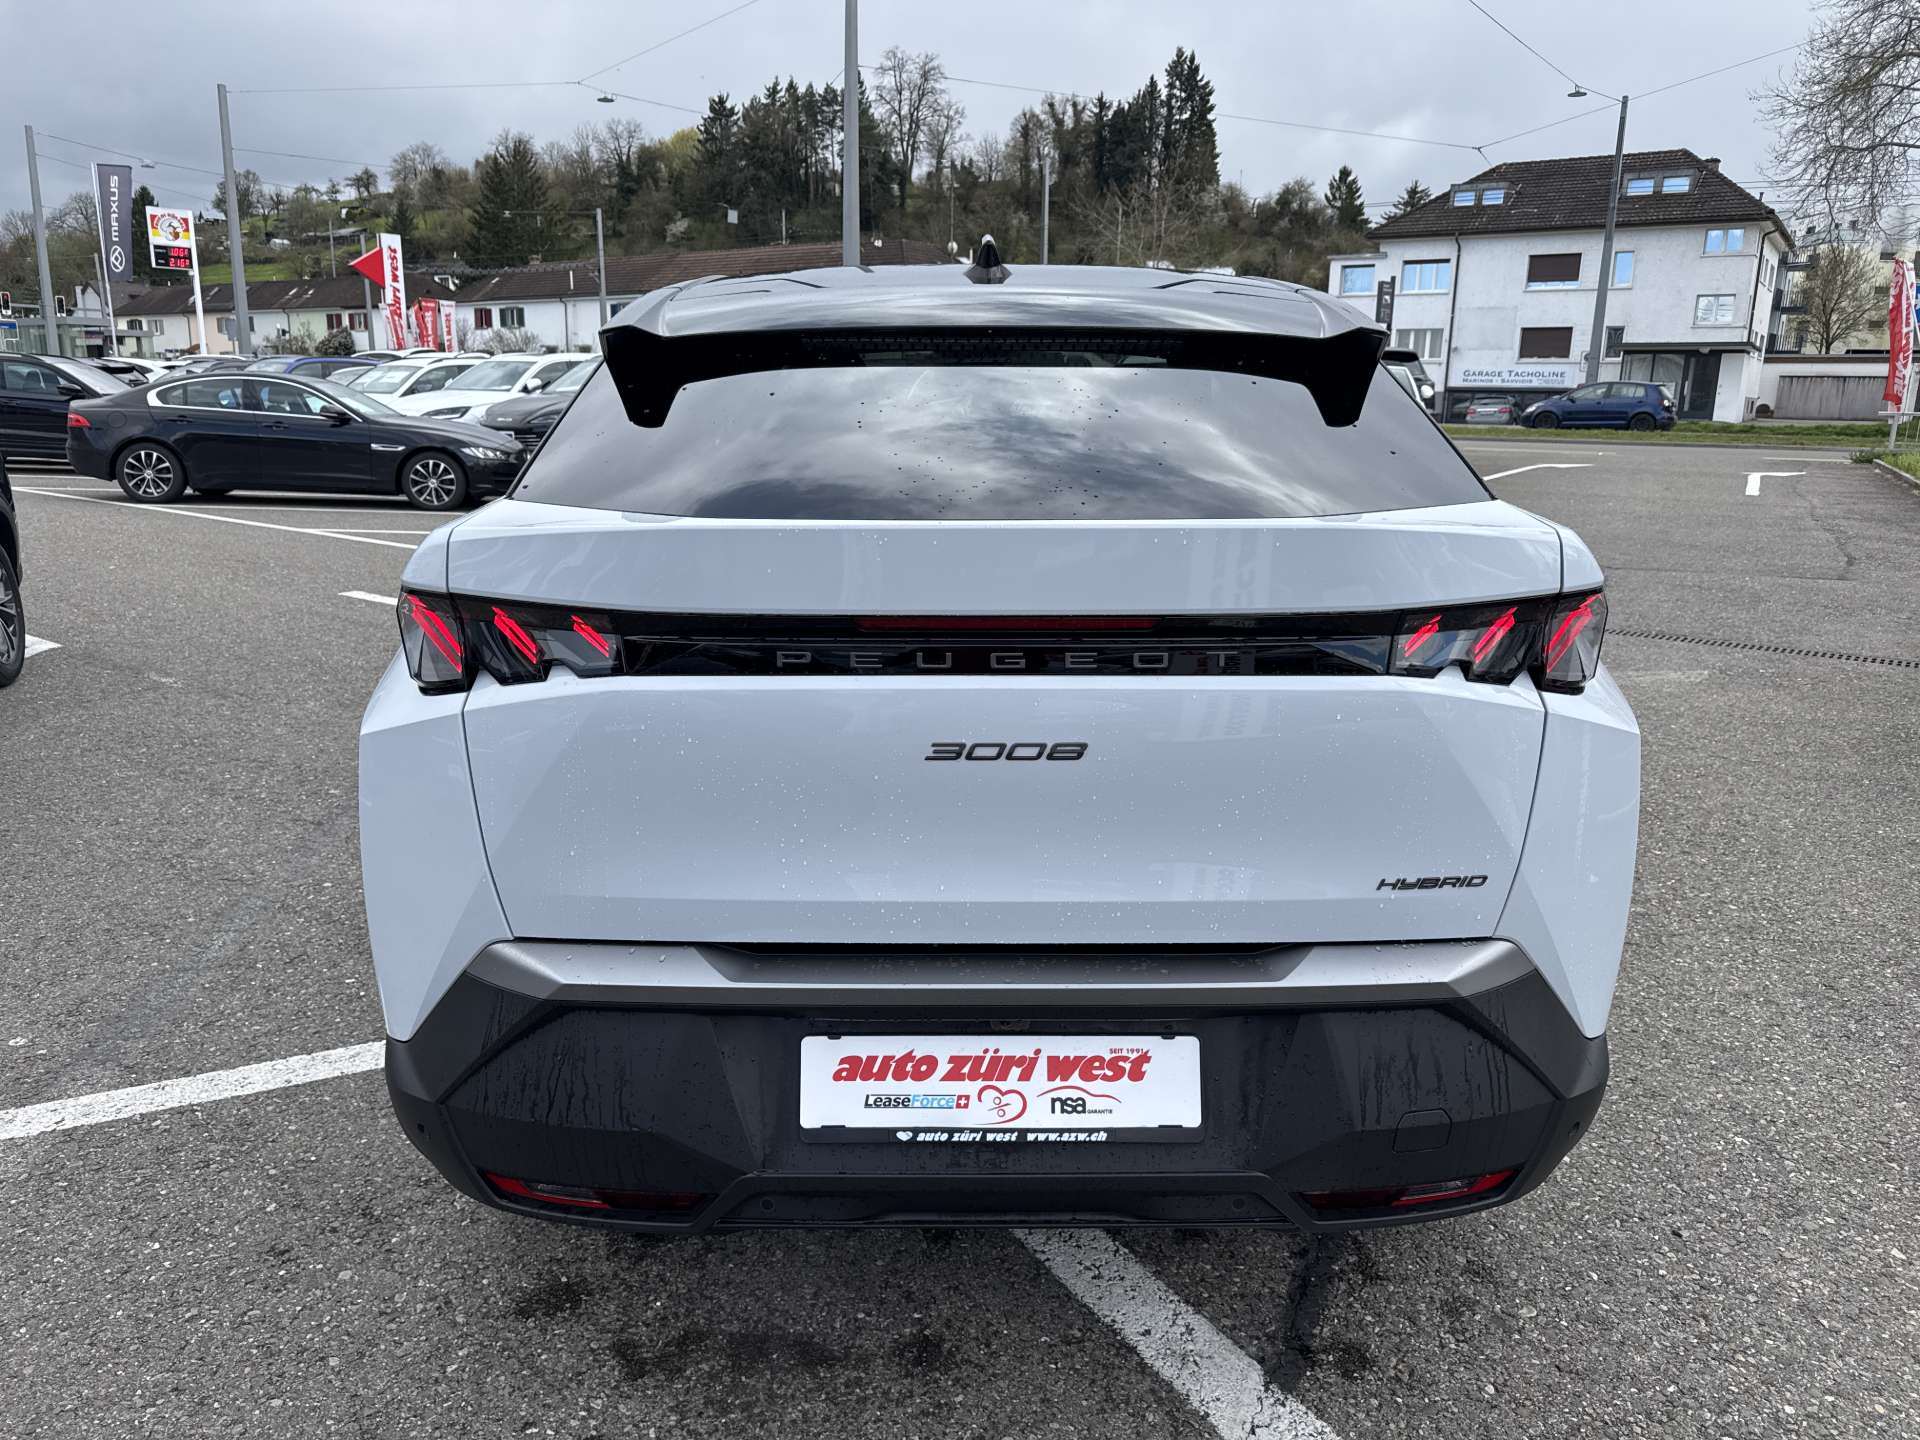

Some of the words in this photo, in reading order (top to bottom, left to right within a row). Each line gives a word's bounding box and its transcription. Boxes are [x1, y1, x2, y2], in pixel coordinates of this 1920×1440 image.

[110, 175, 119, 241] MAXUS
[387, 245, 399, 283] west
[1463, 369, 1503, 378] GARAGE
[1507, 370, 1566, 378] TACHOLINE
[776, 651, 1239, 669] PEUGEOT
[924, 741, 1089, 761] 3008
[1376, 874, 1488, 891] HYBRID
[832, 1048, 939, 1082] auto
[939, 1047, 1042, 1082] züri
[1046, 1049, 1152, 1082] west
[864, 1094, 954, 1108] LeaseForce
[1051, 1096, 1087, 1114] nsa
[916, 1131, 949, 1142] auto
[951, 1130, 982, 1142] züri
[986, 1131, 1018, 1142] west
[1026, 1130, 1108, 1142] www.azw.ch
